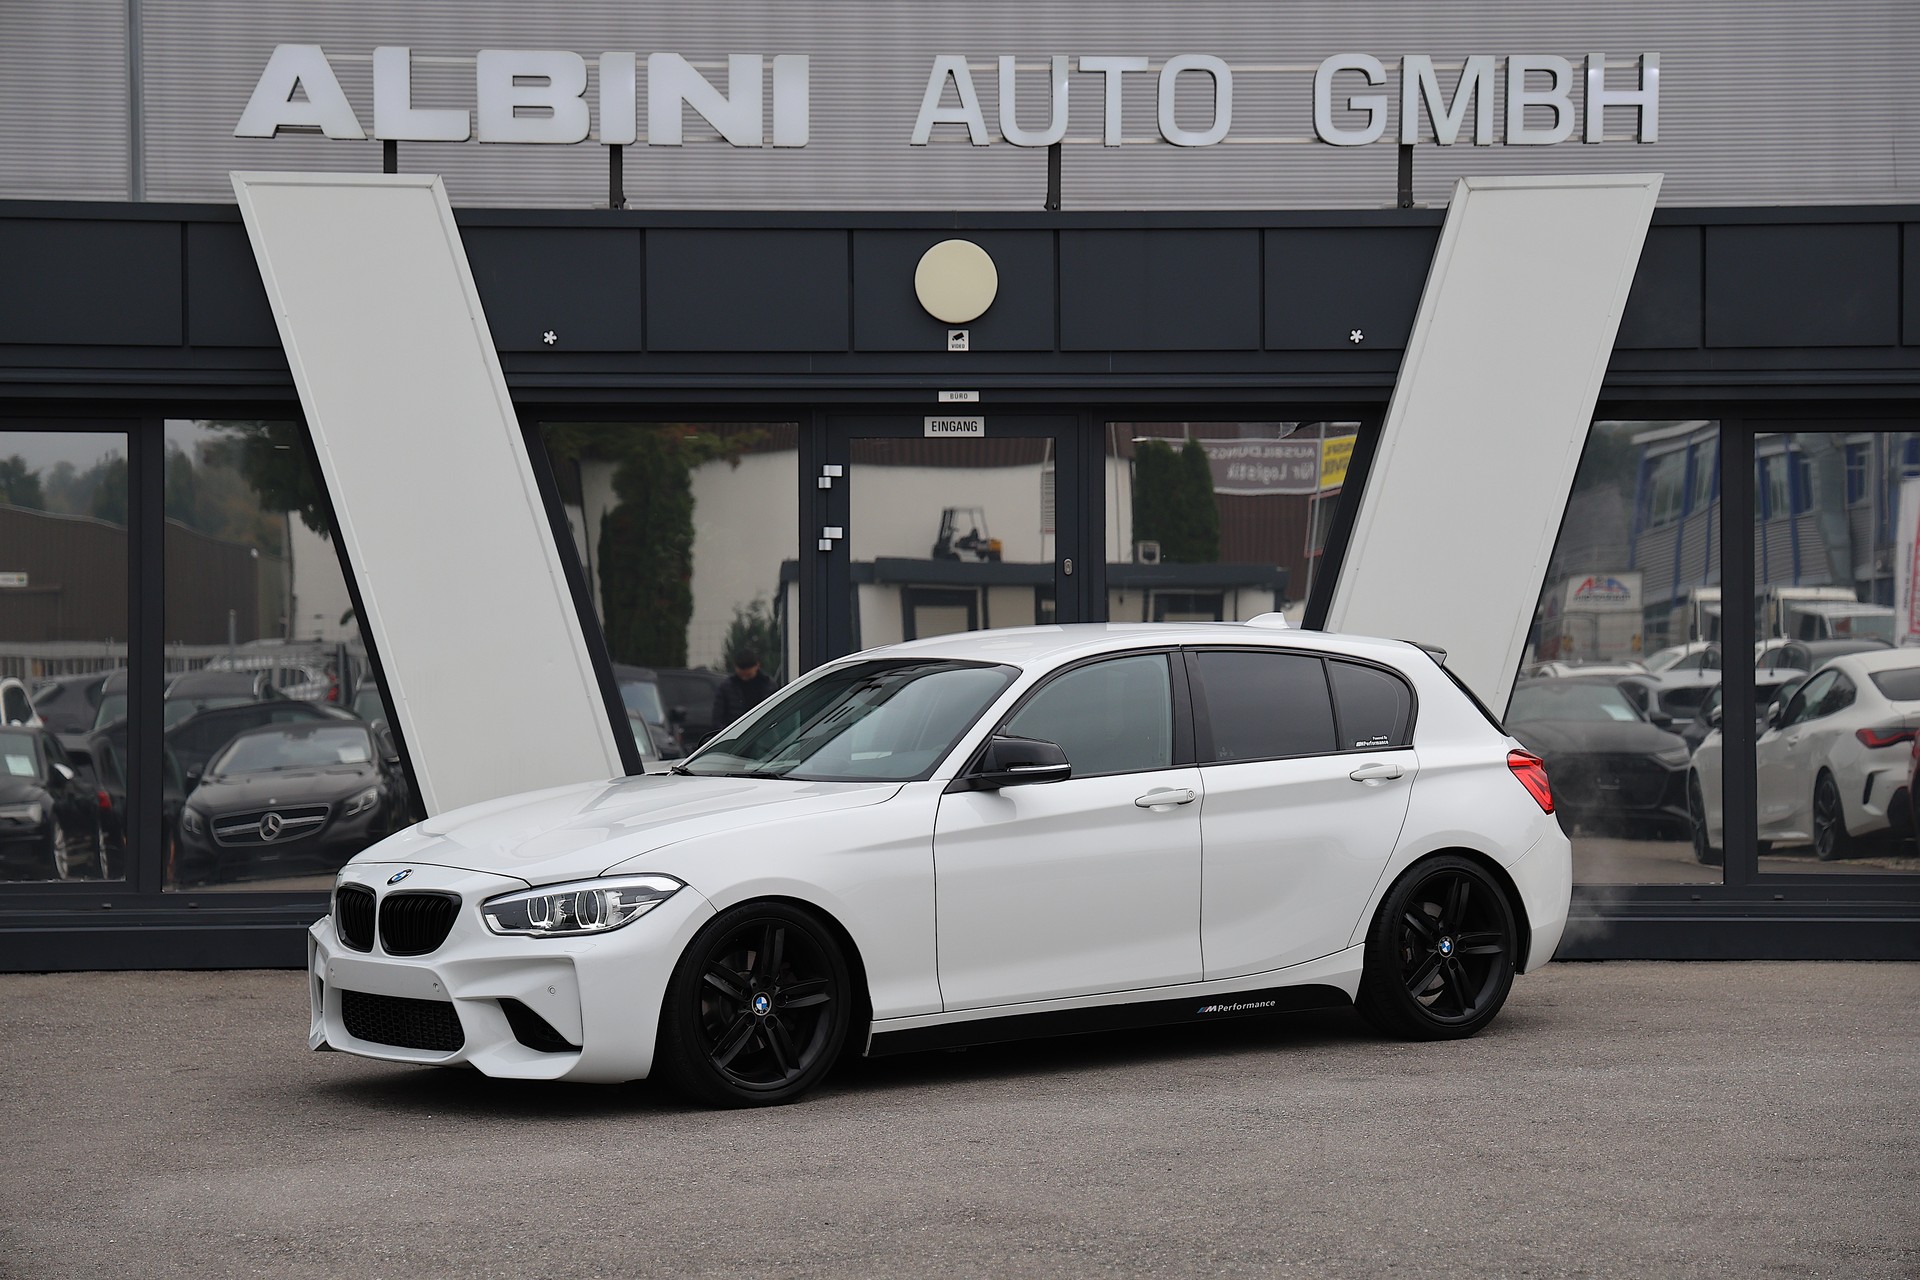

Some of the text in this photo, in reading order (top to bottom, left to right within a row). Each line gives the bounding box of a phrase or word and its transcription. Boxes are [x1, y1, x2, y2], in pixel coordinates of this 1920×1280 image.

[234, 44, 1660, 147] ALBINI AUTO GMBH
[949, 392, 968, 400] BÜRO
[931, 420, 978, 432] EINGANG
